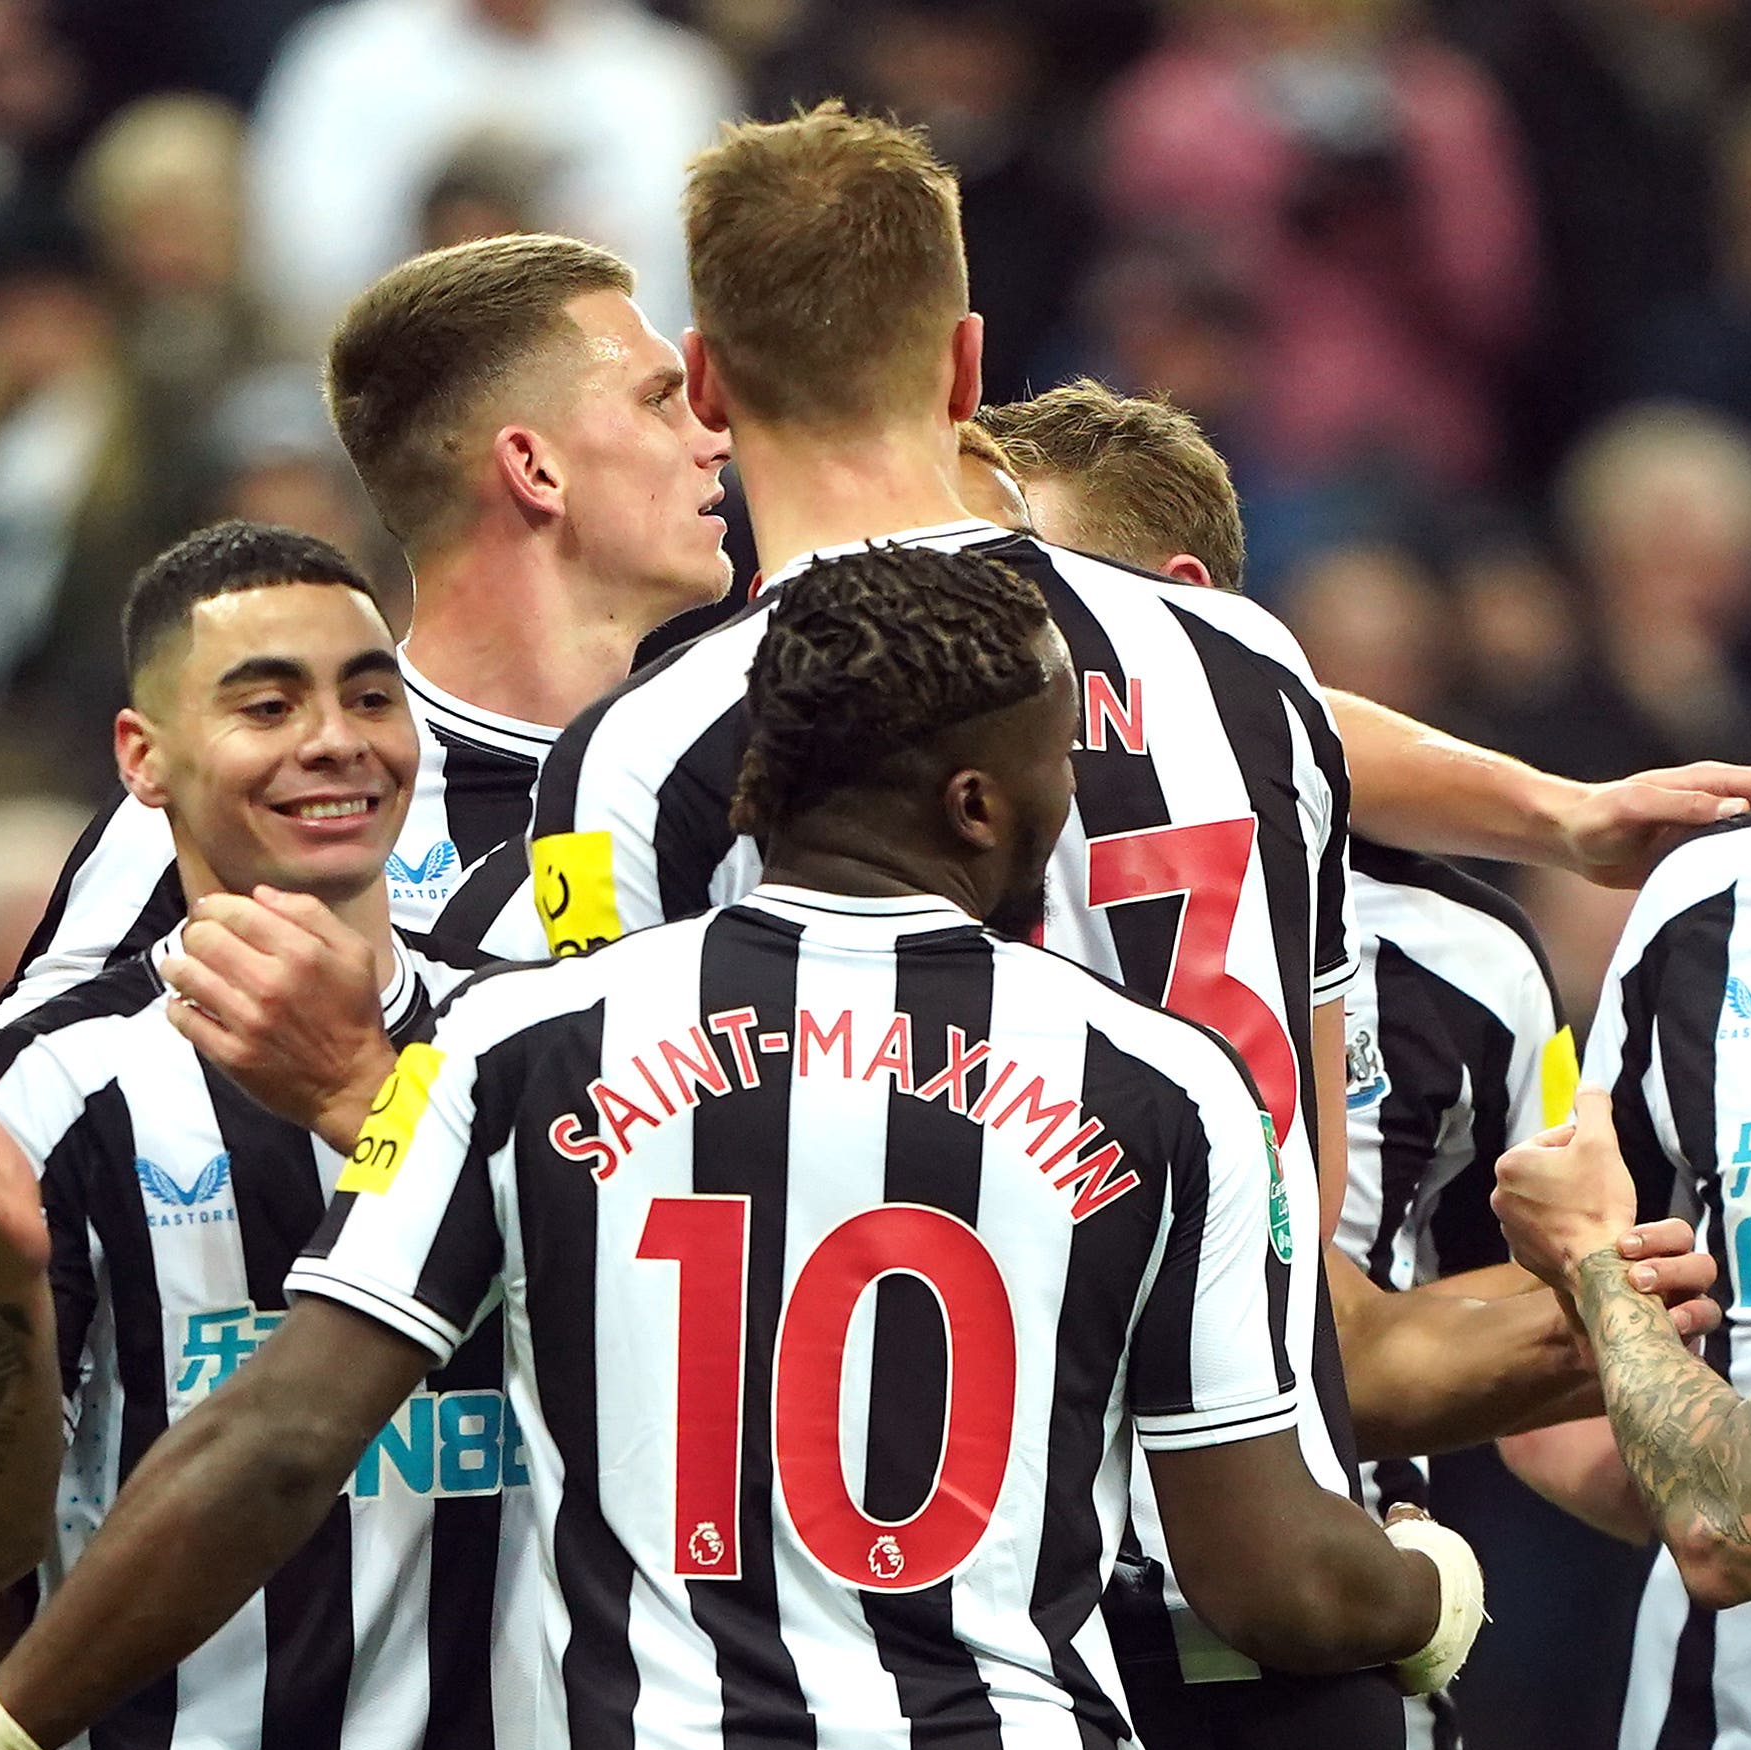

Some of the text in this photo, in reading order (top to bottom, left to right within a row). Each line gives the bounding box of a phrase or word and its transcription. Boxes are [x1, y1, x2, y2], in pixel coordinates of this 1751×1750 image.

[1086, 811, 1297, 1147] 3
[148, 1207, 237, 1226] CASTORE
[351, 1134, 399, 1171] on
[548, 1005, 1141, 1224] SAINT-MAXIMIN
[635, 1192, 1017, 1593] 10
